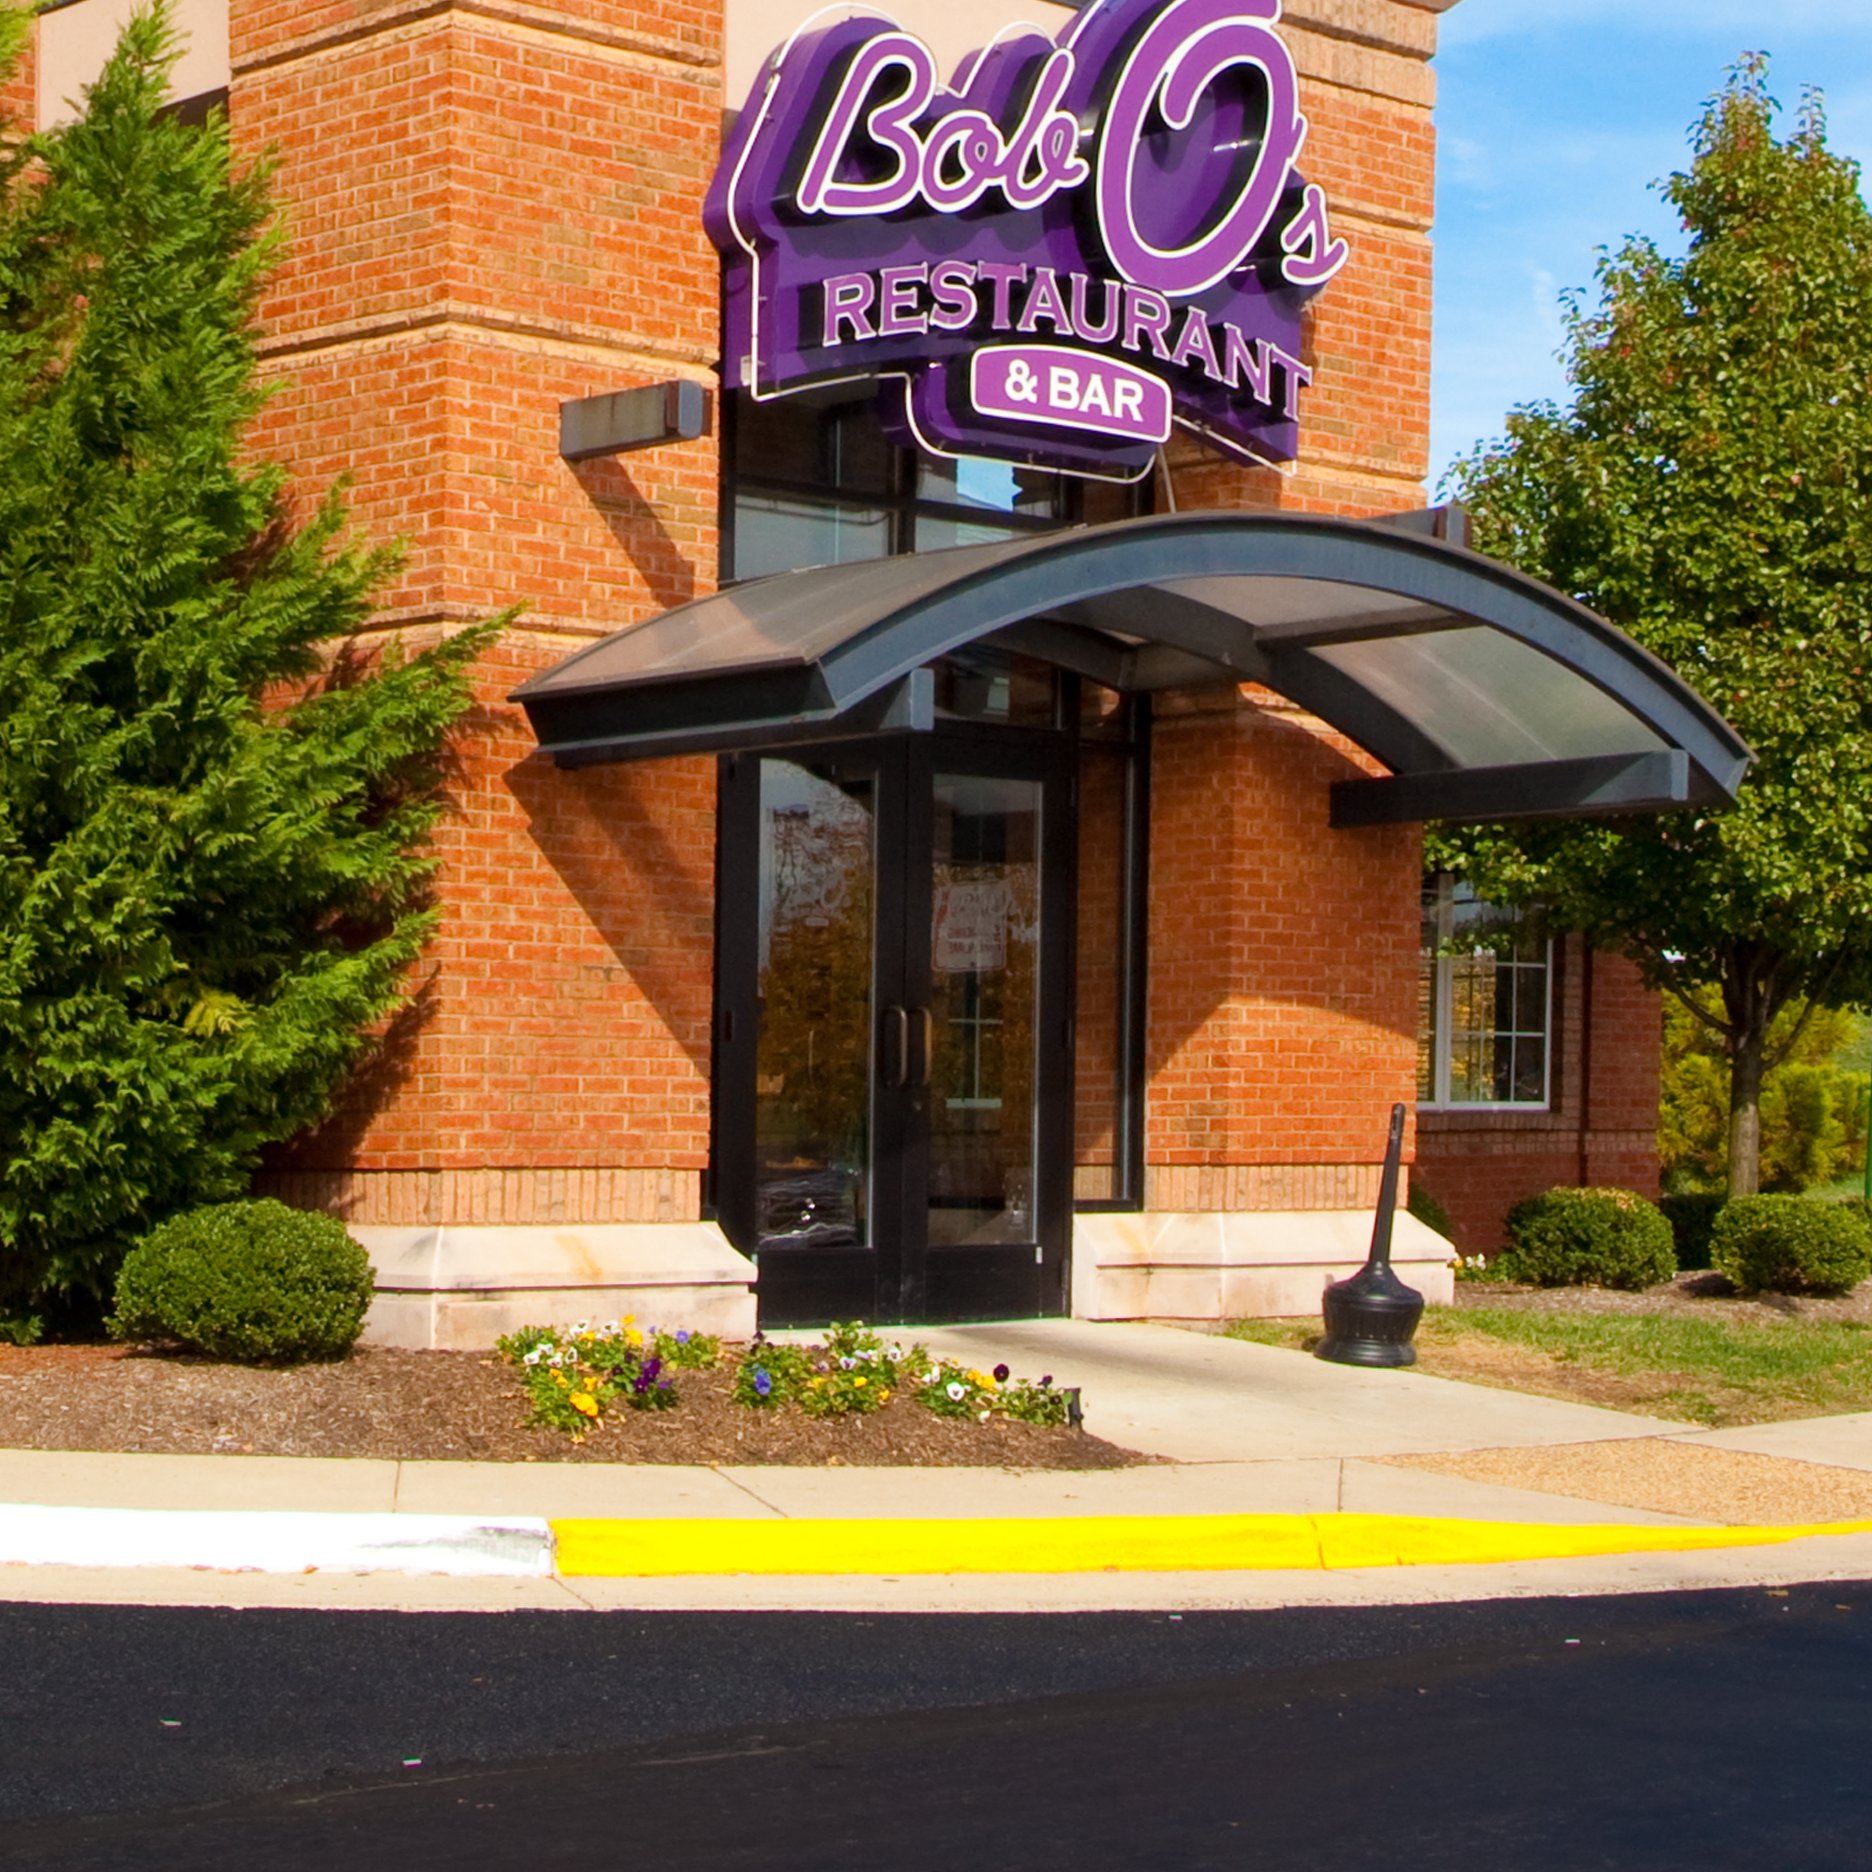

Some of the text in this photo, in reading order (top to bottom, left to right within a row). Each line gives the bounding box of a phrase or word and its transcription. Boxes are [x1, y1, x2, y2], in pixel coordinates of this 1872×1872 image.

[797, 32, 1089, 215] Bob
[822, 260, 1312, 422] RESTAURANT
[1005, 359, 1144, 422] & BAR
